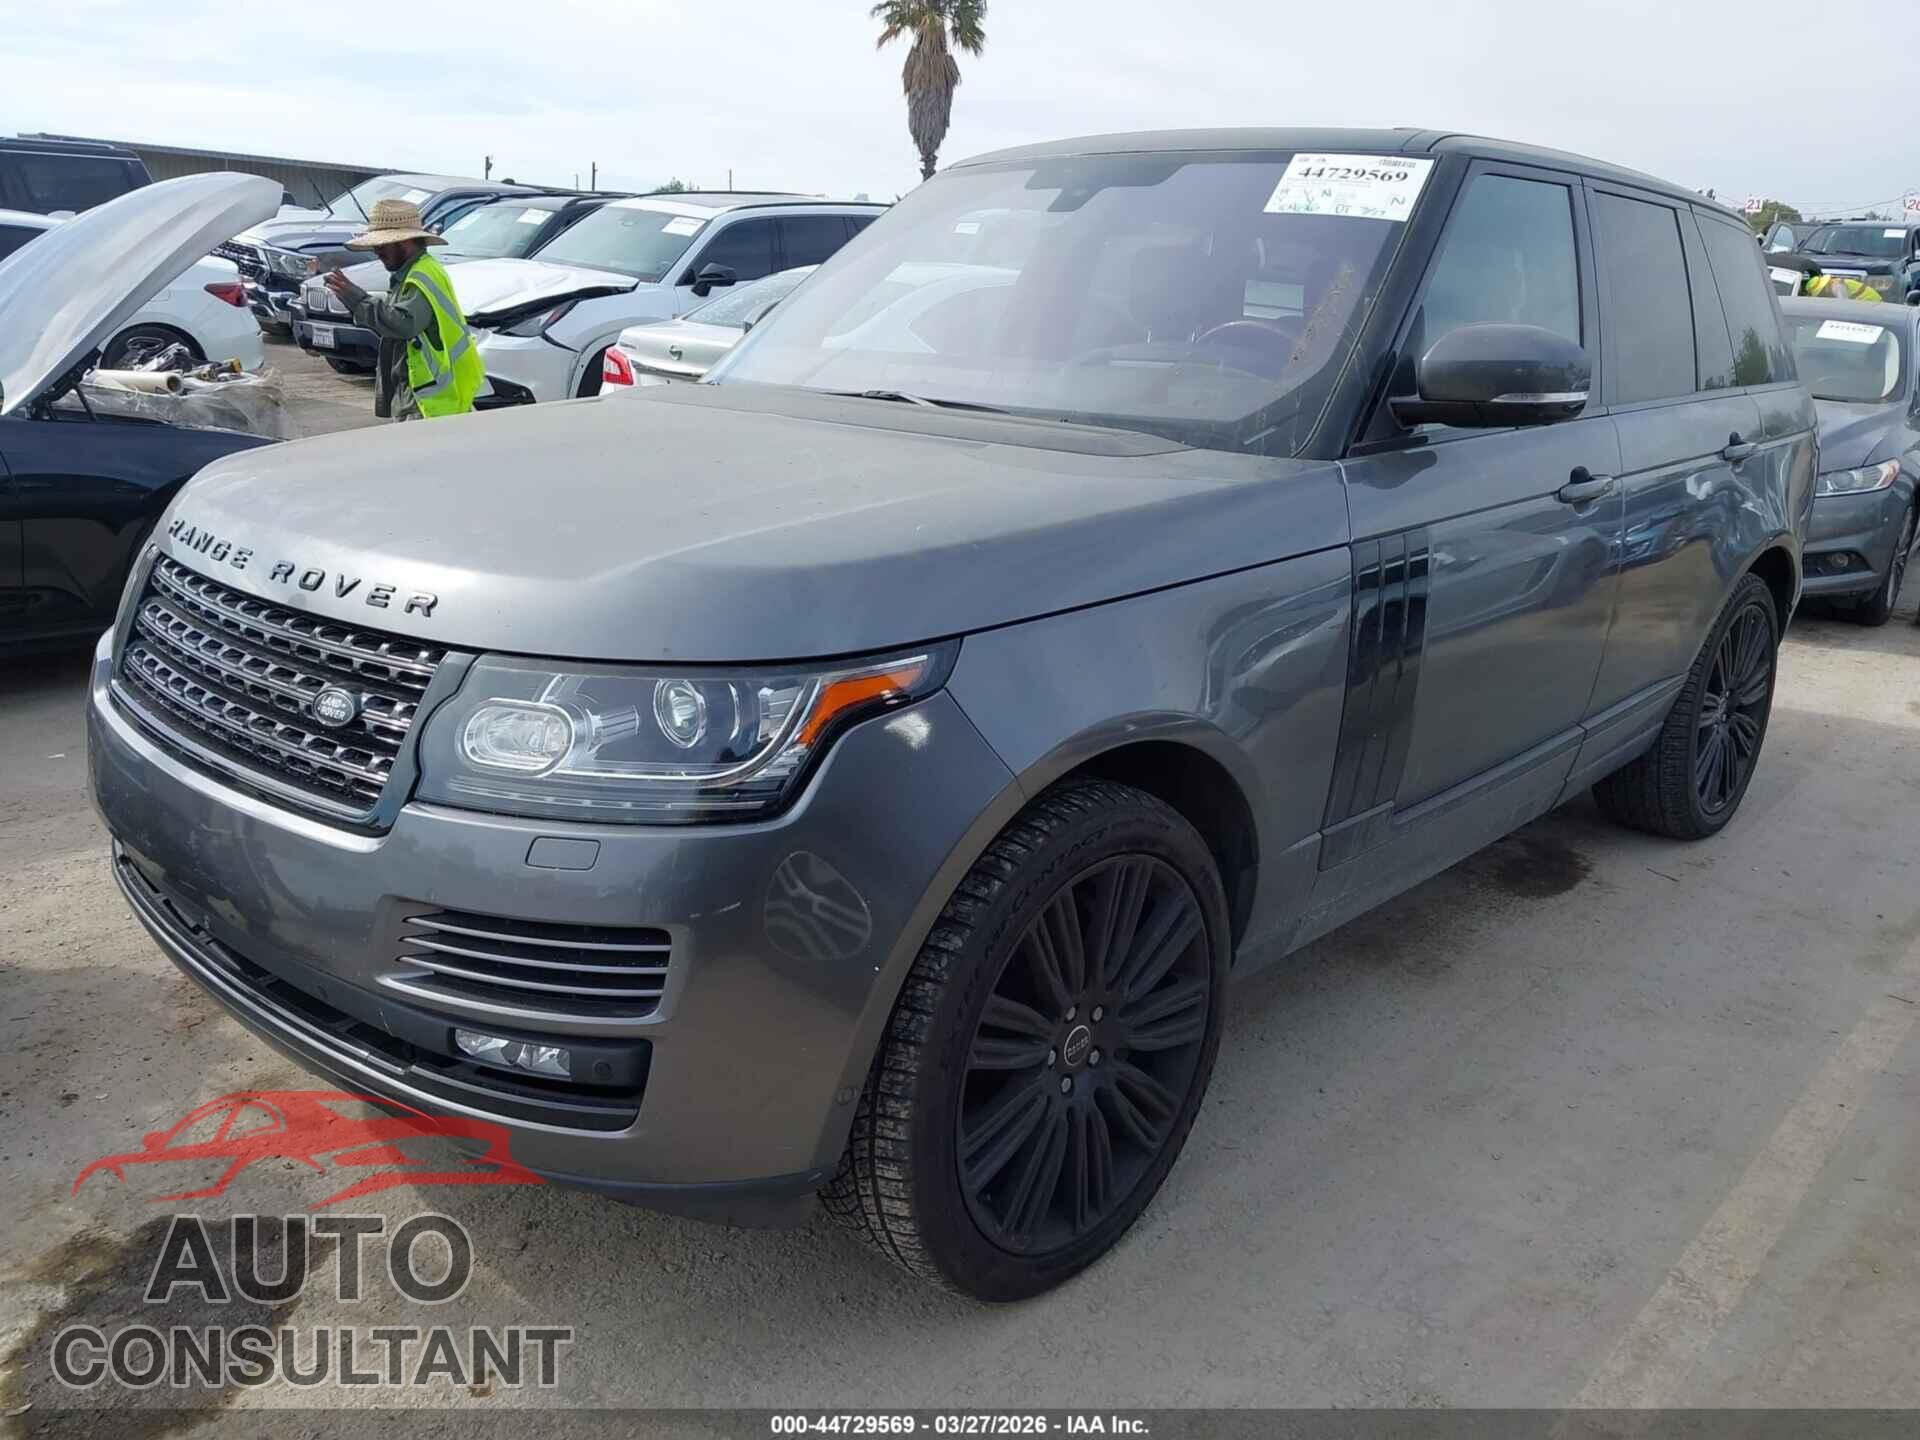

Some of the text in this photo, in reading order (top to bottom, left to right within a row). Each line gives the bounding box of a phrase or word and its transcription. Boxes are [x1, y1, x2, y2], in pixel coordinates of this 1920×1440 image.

[1298, 167, 1409, 182] 44729569
[168, 519, 439, 618] RANGE ROVER
[320, 695, 343, 708] LAND
[319, 704, 346, 721] ROVER
